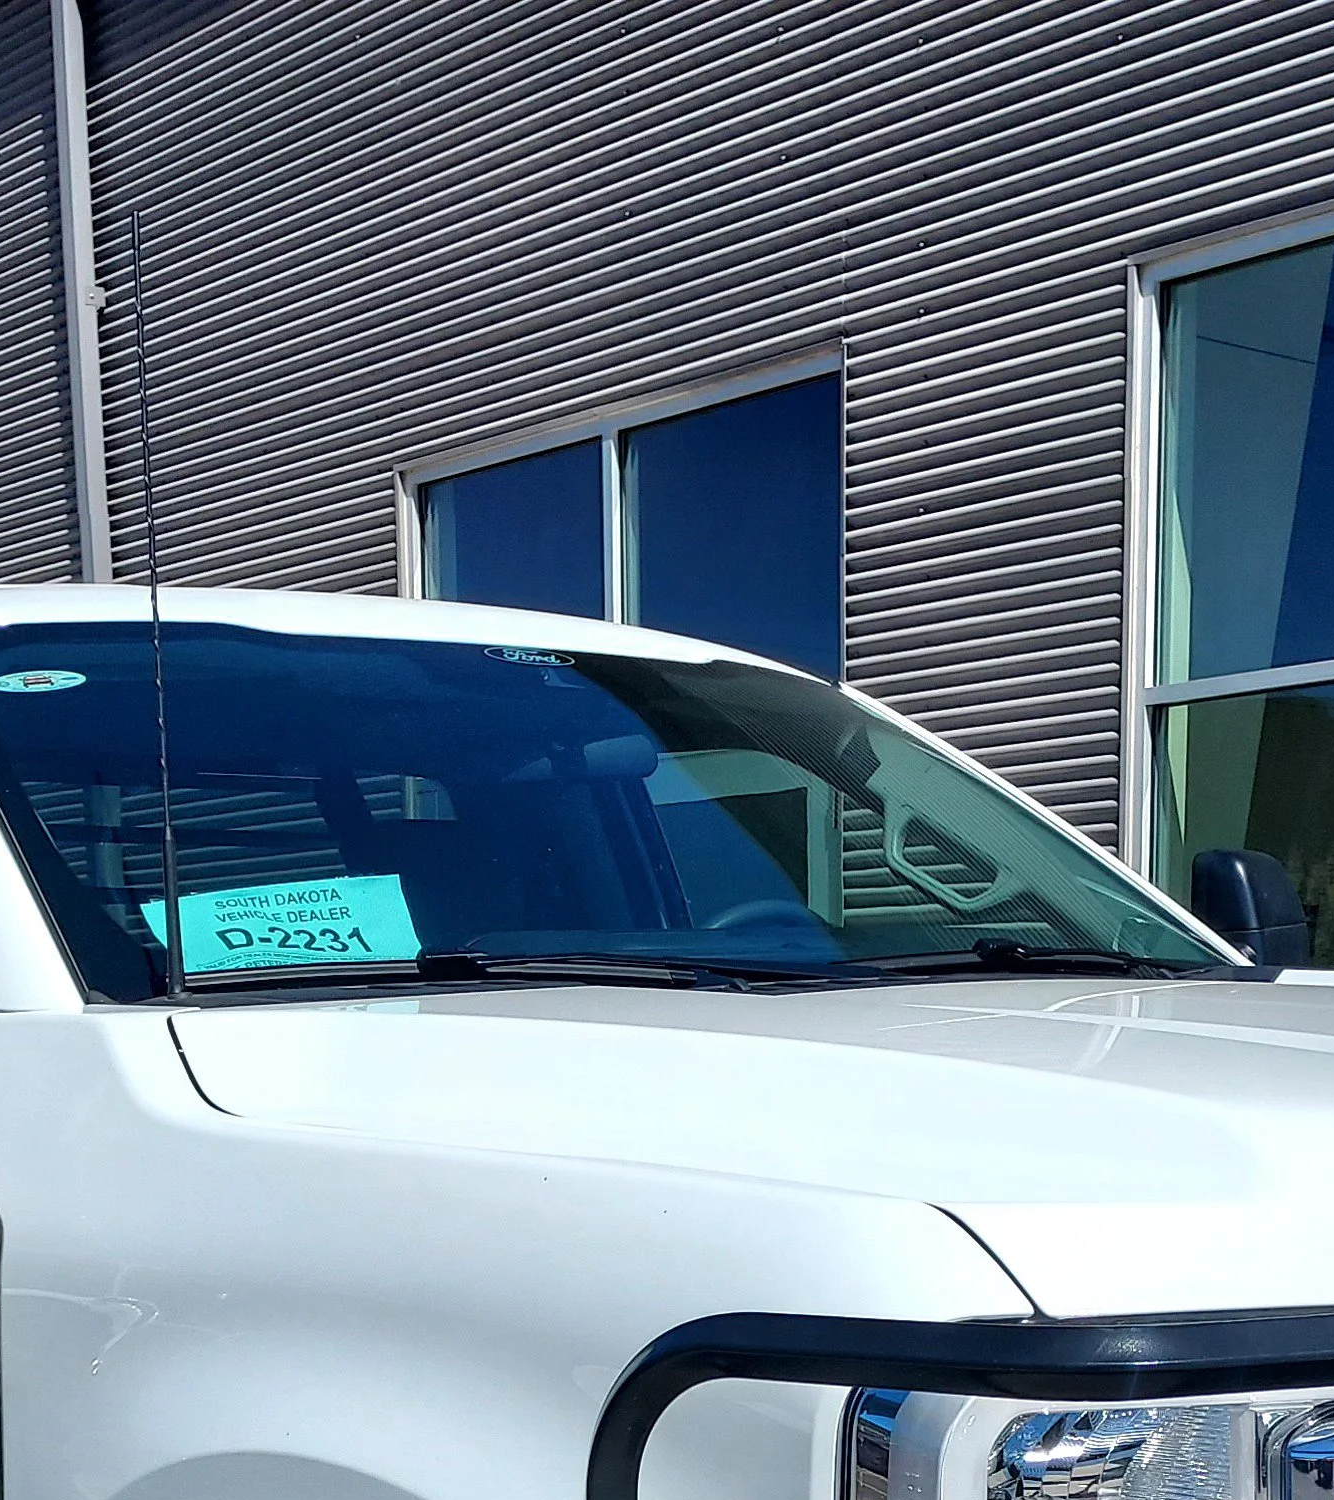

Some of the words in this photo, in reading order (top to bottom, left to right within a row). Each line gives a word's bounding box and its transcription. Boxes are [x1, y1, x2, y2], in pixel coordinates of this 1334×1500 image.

[502, 647, 561, 664] Ford
[214, 896, 271, 910] SOUTH
[275, 887, 343, 907] DAKOTA
[214, 909, 283, 924] VEHICLE
[286, 906, 352, 924] DEALER
[214, 925, 374, 954] D-2231
